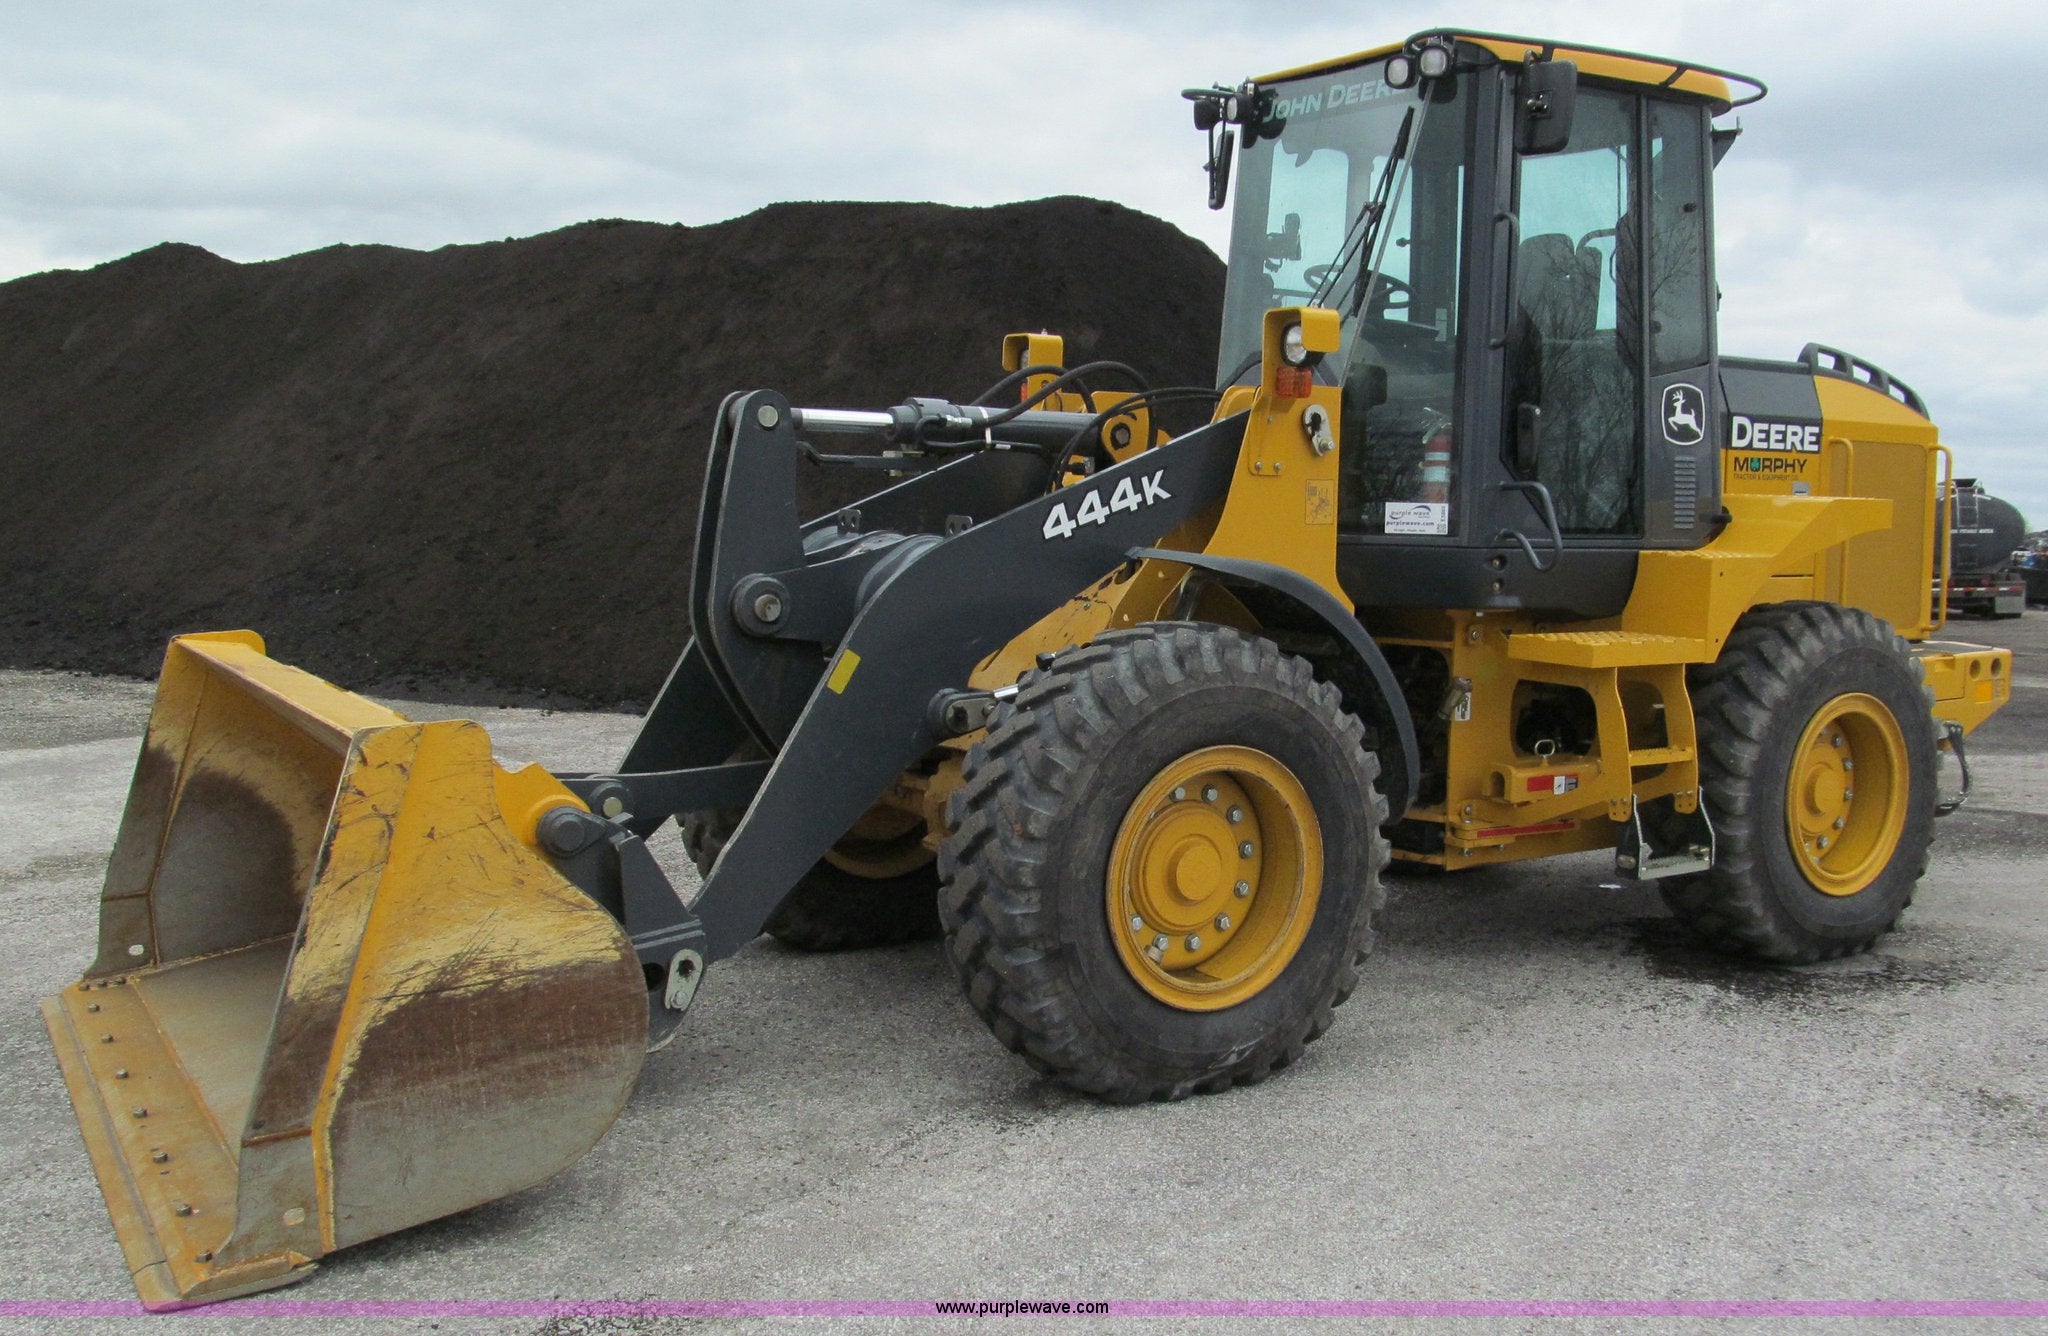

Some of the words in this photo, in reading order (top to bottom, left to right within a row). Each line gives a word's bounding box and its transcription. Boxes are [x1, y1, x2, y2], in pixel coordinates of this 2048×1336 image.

[1262, 93, 1323, 123] JOHN
[1326, 79, 1406, 110] DEER
[1731, 415, 1820, 452] DEERE
[1733, 457, 1808, 473] MURPHY
[1042, 469, 1172, 540] 444K
